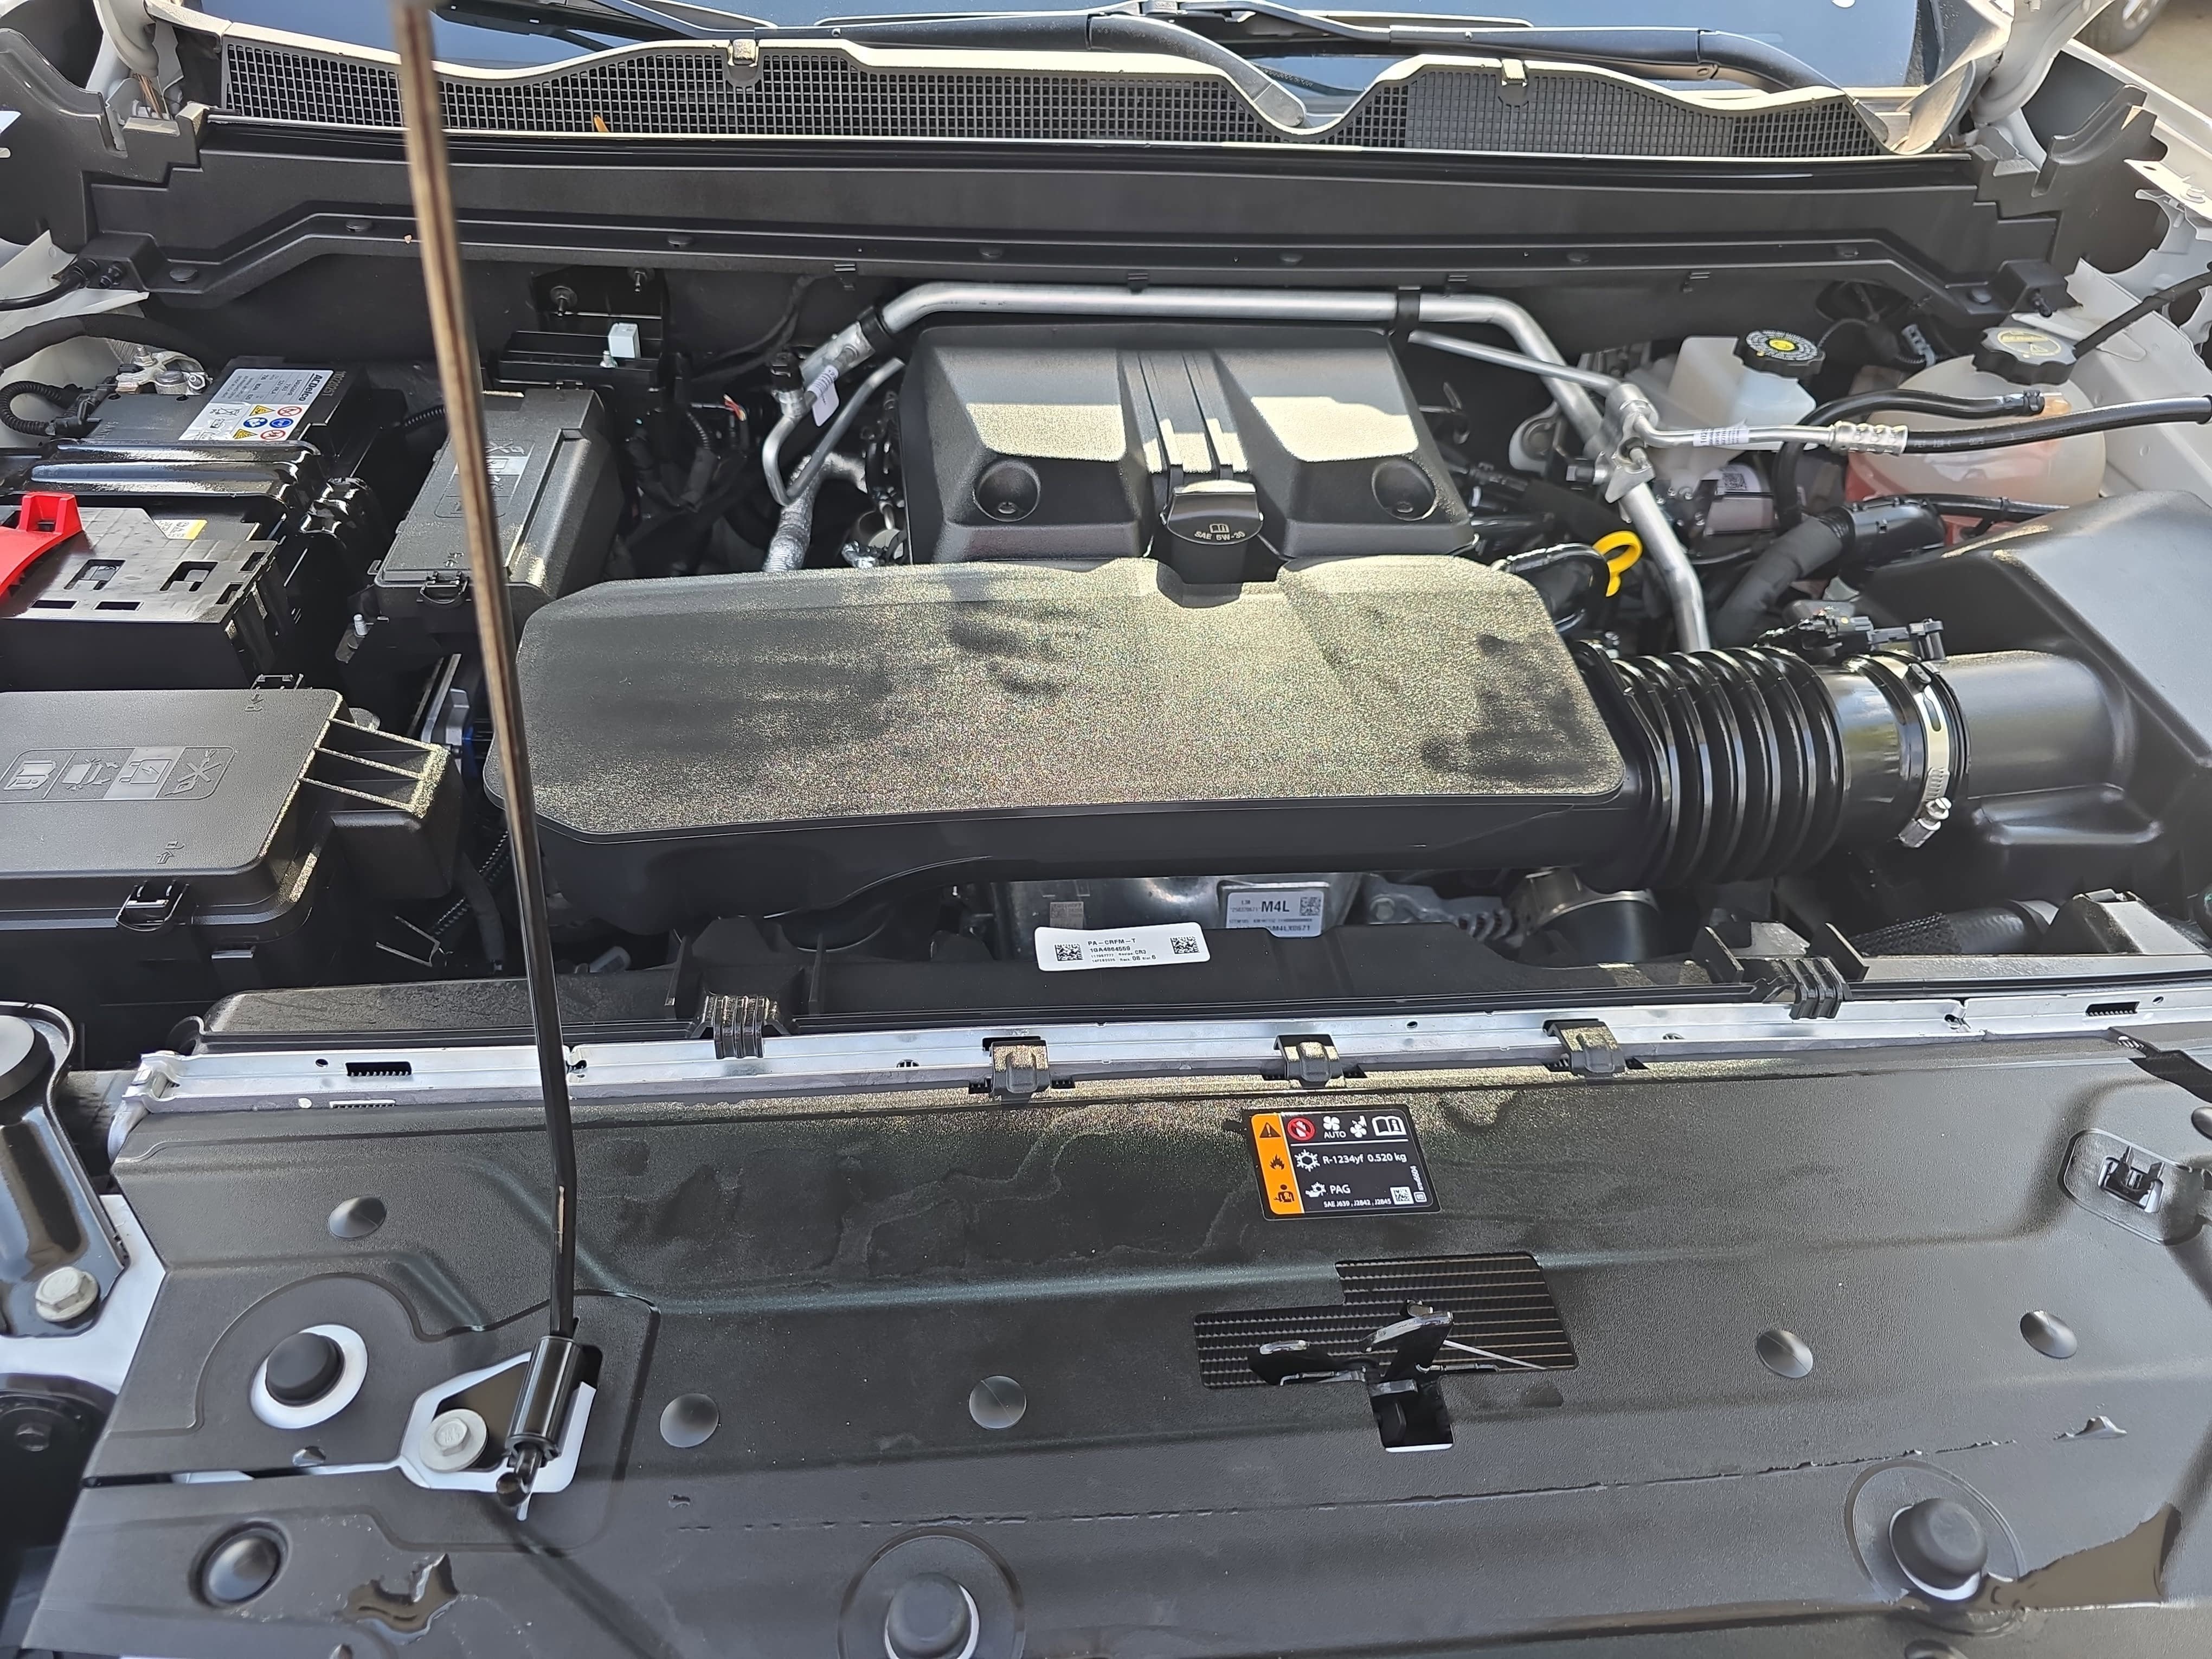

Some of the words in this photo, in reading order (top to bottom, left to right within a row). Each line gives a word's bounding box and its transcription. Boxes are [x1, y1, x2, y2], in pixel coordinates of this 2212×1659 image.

[299, 374, 323, 402] ACDelco
[1194, 531, 1212, 540] SAE
[1216, 531, 1246, 541] 5W-30
[1261, 901, 1290, 912] M4L
[1324, 1130, 1347, 1139] AUTO
[1322, 1154, 1364, 1165] R-1234yf
[1367, 1153, 1393, 1162] 0.520
[1394, 1152, 1407, 1163] kg
[1329, 1184, 1351, 1194] PAG
